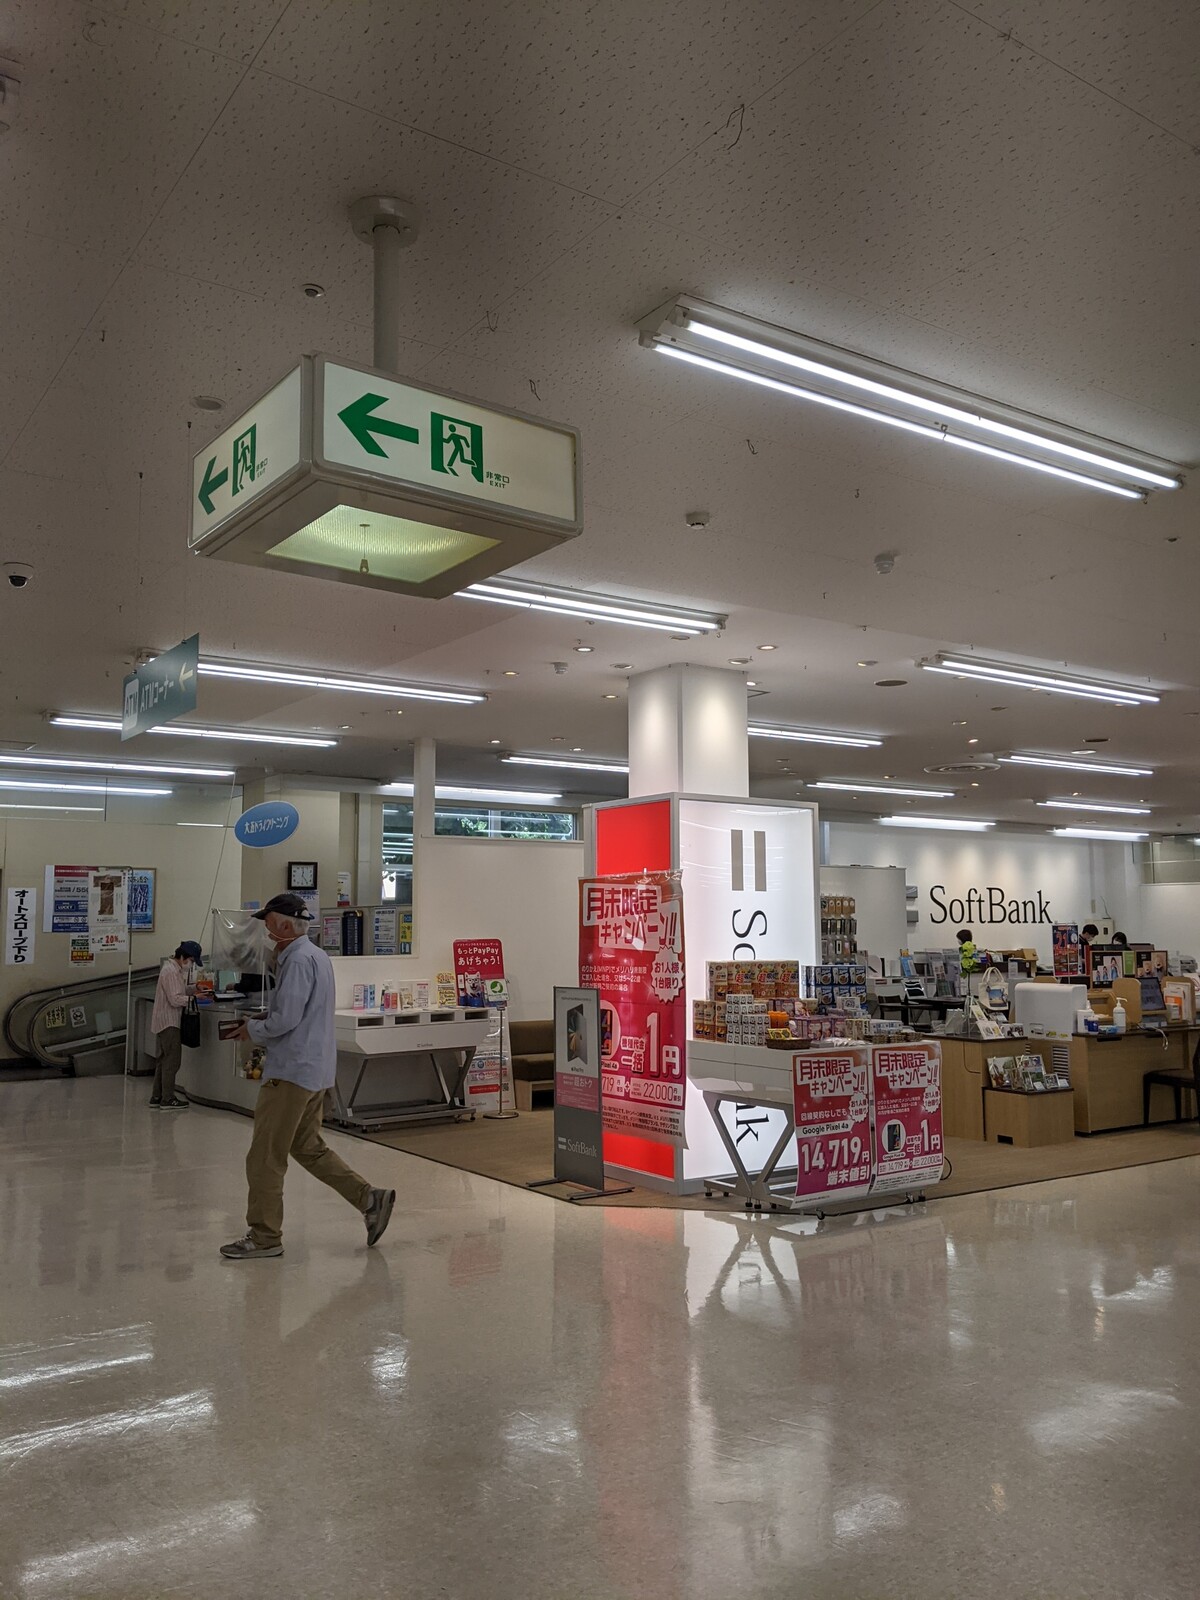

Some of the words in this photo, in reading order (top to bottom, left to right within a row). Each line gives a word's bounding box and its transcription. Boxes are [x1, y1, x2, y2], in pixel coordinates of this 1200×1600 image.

[486, 471, 510, 484] 非常口
[489, 480, 506, 489] EXIT
[125, 690, 138, 719] ATM
[140, 673, 175, 713] ATMコーナー
[587, 887, 658, 921] 月末限定
[929, 884, 1053, 925] SoftBank
[12, 889, 29, 964] オートスロープ下り
[457, 946, 499, 956] もっとPayPay
[458, 955, 501, 966] あげちゃう!
[800, 1057, 851, 1082] 月末限定
[878, 1052, 926, 1073] 月末限定
[802, 1126, 825, 1135] Google
[825, 1122, 841, 1132] Pixel
[567, 1136, 597, 1159] SoftBank
